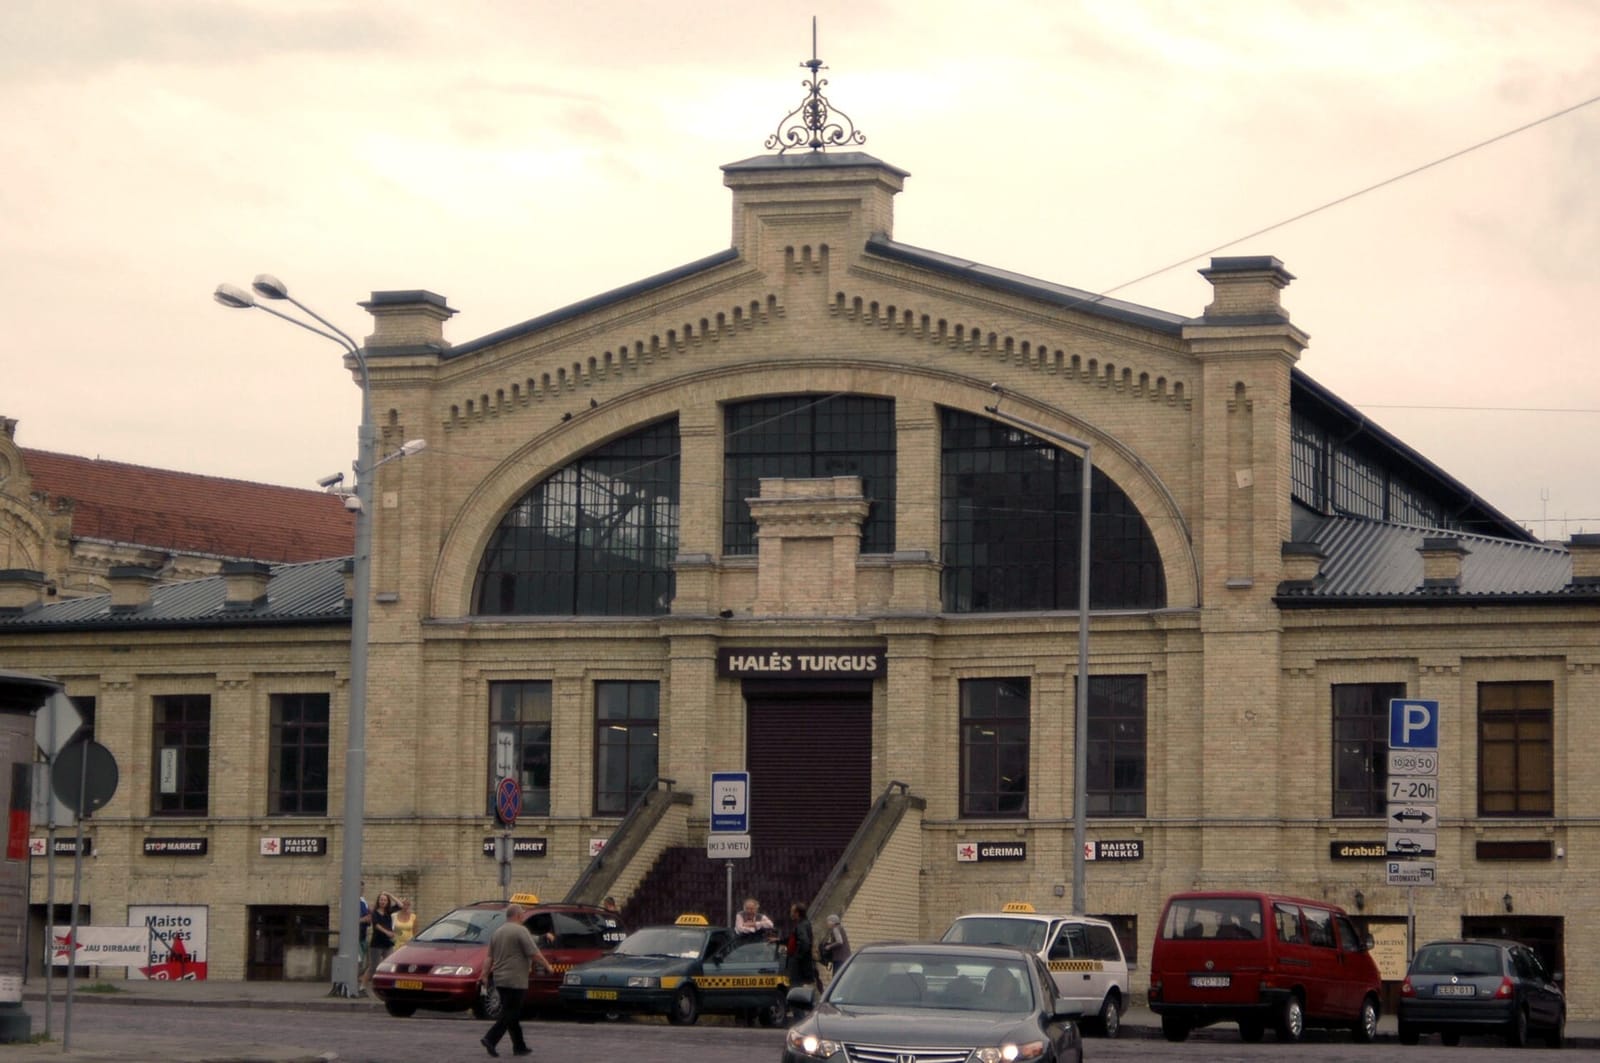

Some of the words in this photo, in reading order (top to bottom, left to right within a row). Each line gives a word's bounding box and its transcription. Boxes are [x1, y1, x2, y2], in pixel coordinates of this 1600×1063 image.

[797, 655, 877, 671] TURGUS
[1403, 704, 1431, 743] P
[1404, 759, 1416, 767] 20
[1418, 758, 1432, 769] 50
[145, 843, 166, 851] STOP
[167, 842, 202, 850] MARKET
[285, 838, 318, 846] MAISTO
[1101, 842, 1139, 850] MAISTO
[514, 843, 544, 851] ARKET
[1341, 846, 1387, 856] drabuži
[145, 915, 192, 927] Maisto
[102, 944, 140, 952] DIRBAME
